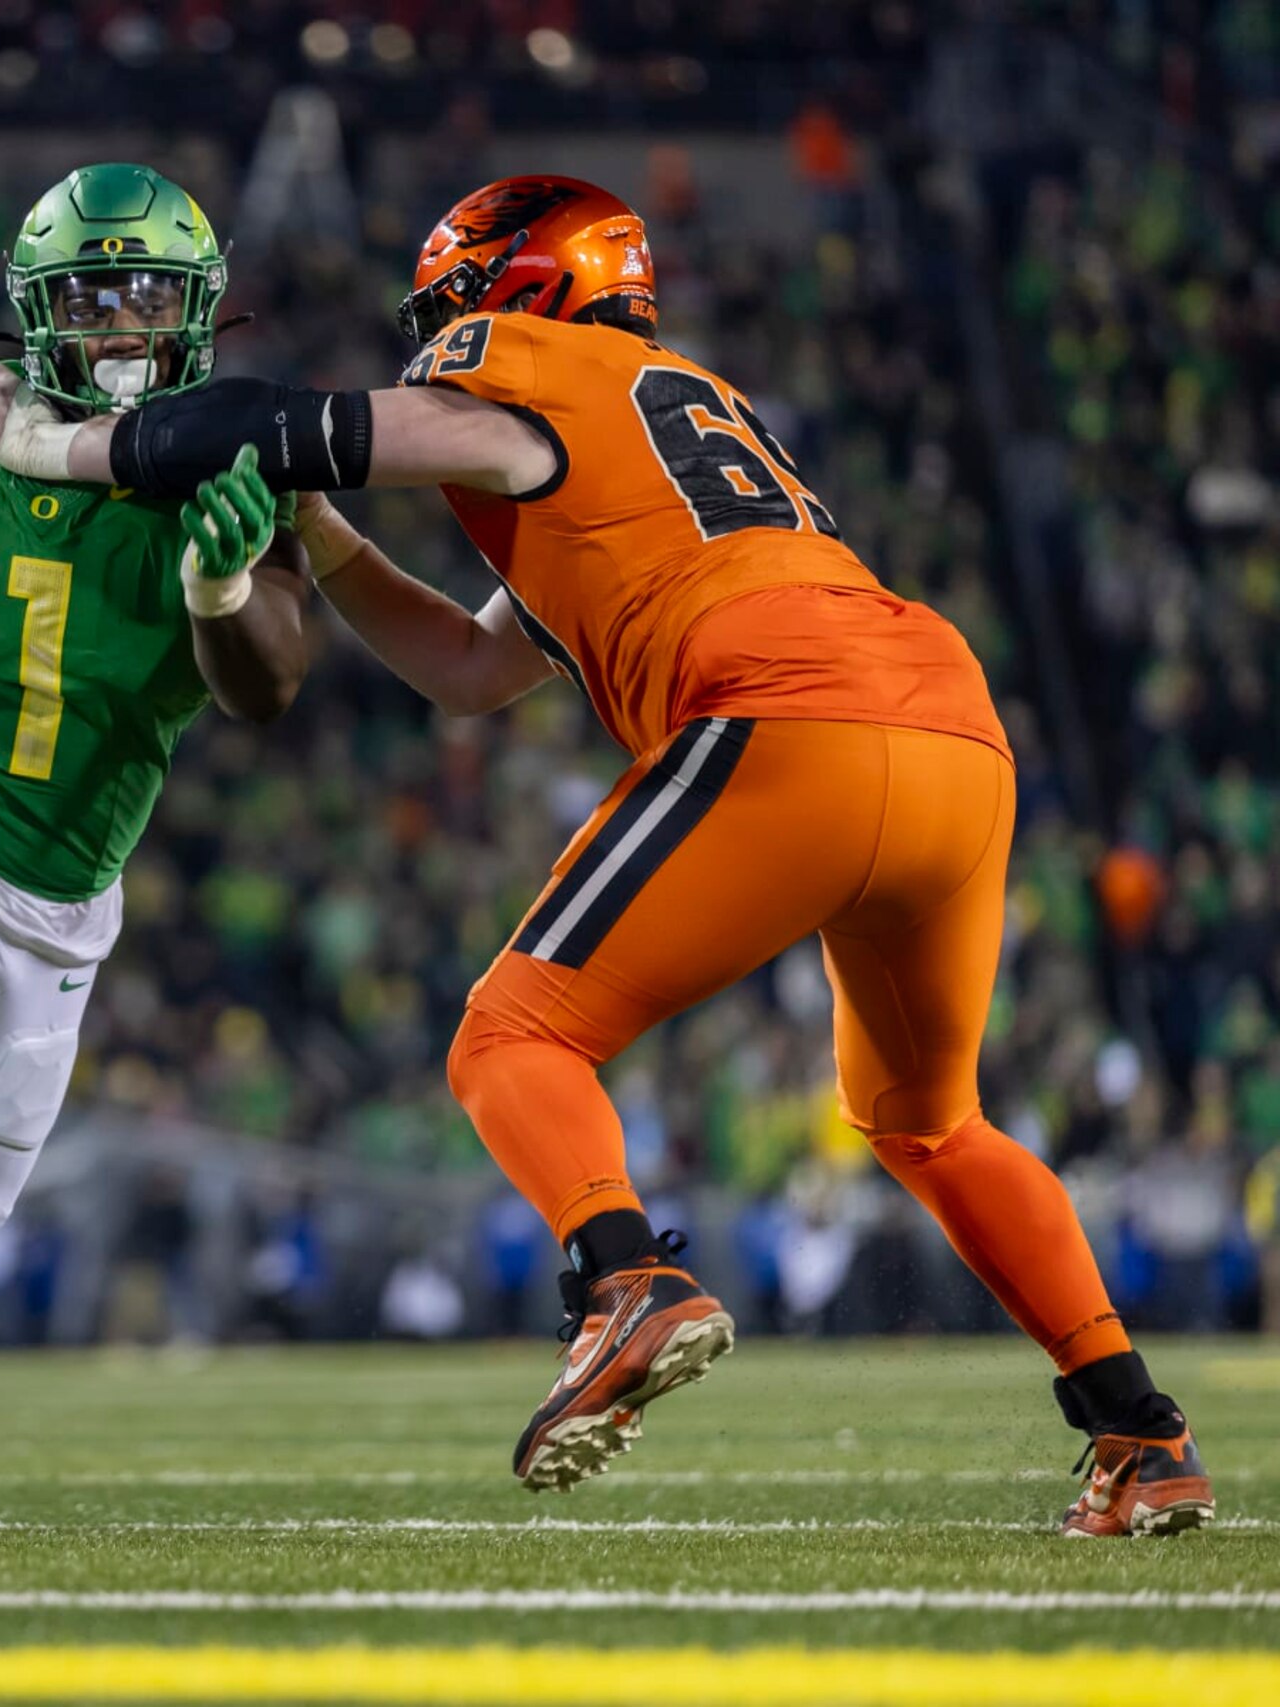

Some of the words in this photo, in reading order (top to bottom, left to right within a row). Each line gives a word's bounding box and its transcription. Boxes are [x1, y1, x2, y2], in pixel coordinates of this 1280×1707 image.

[102, 237, 124, 255] O
[401, 316, 495, 386] 69
[30, 495, 59, 519] O
[6, 555, 73, 780] 1
